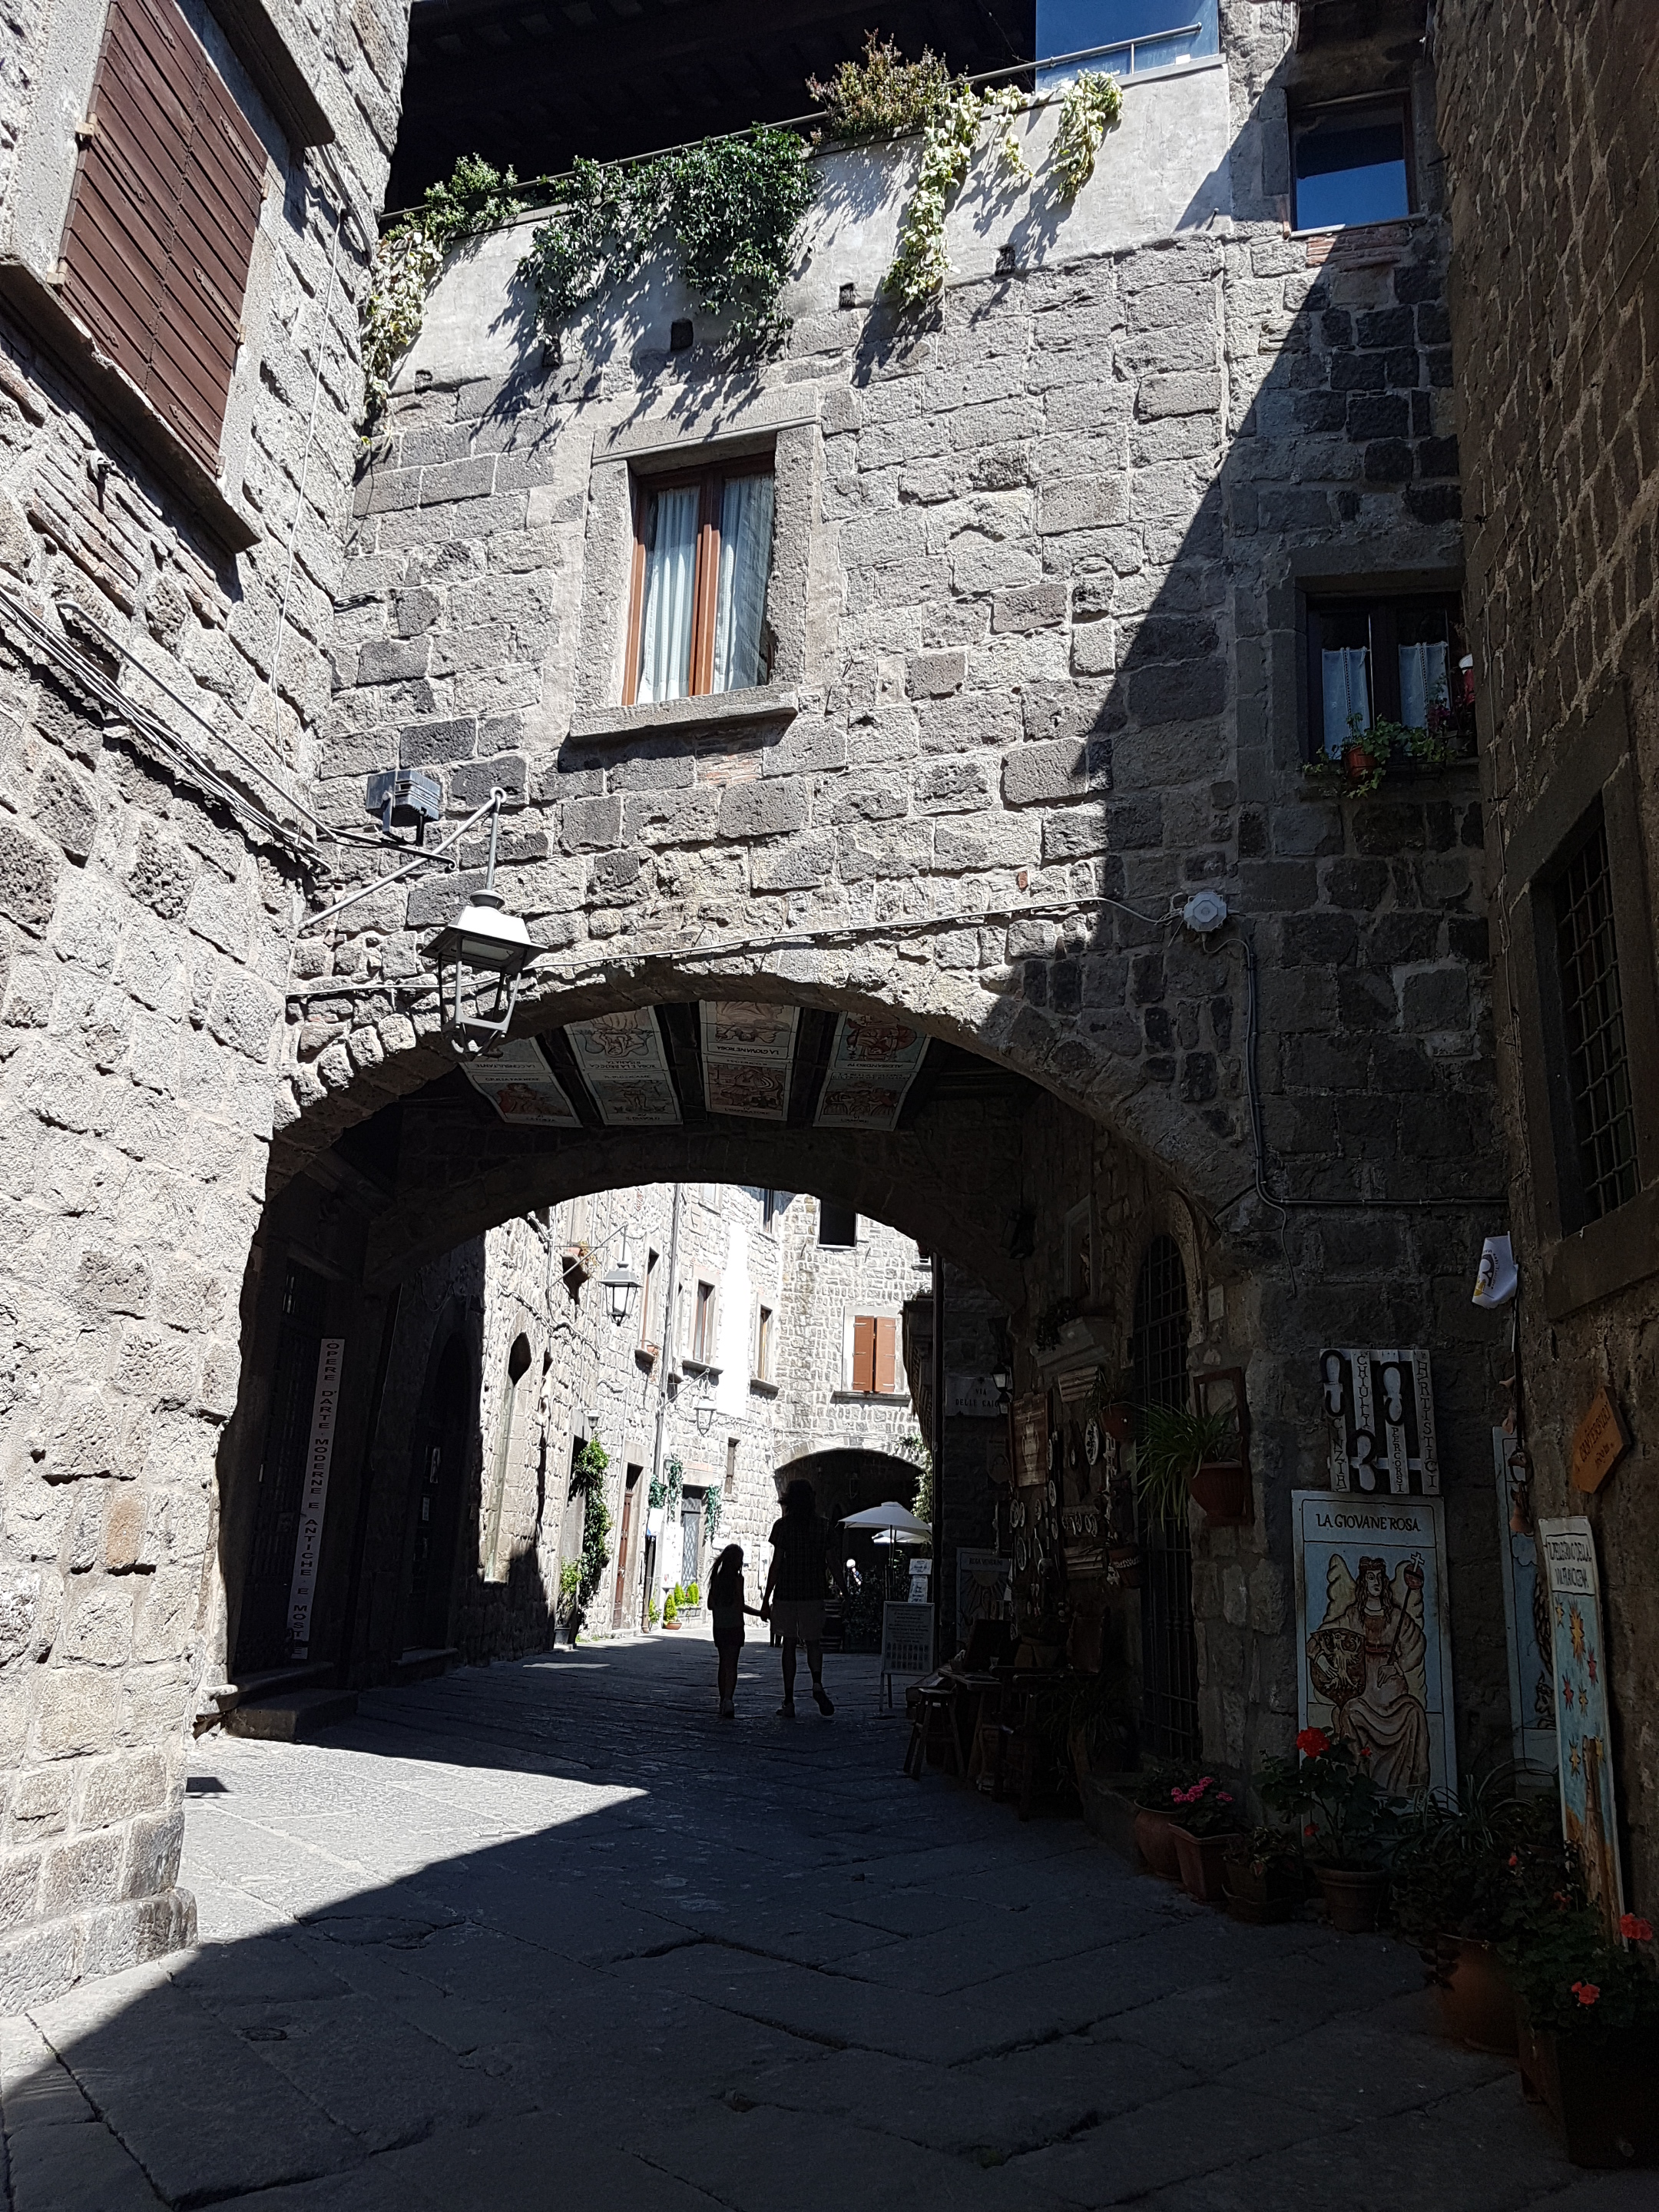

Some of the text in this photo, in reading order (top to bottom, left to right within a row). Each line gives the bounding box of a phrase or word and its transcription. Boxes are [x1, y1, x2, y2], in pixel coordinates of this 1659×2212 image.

[324, 1343, 339, 1381] OPERE
[319, 1390, 337, 1429] D'ARTE
[955, 1399, 977, 1407] DELLE
[1356, 1355, 1372, 1427] CHIULLI
[1416, 1359, 1437, 1488] ARTISTICI
[310, 1439, 329, 1495] MODERNE
[1333, 1418, 1347, 1492] CINZIA
[1391, 1427, 1405, 1493] PERCORSI
[300, 1518, 318, 1576] ANTICHE
[1315, 1513, 1421, 1532] LA GIOVANE ROSA
[293, 1604, 307, 1654] MOSTE
